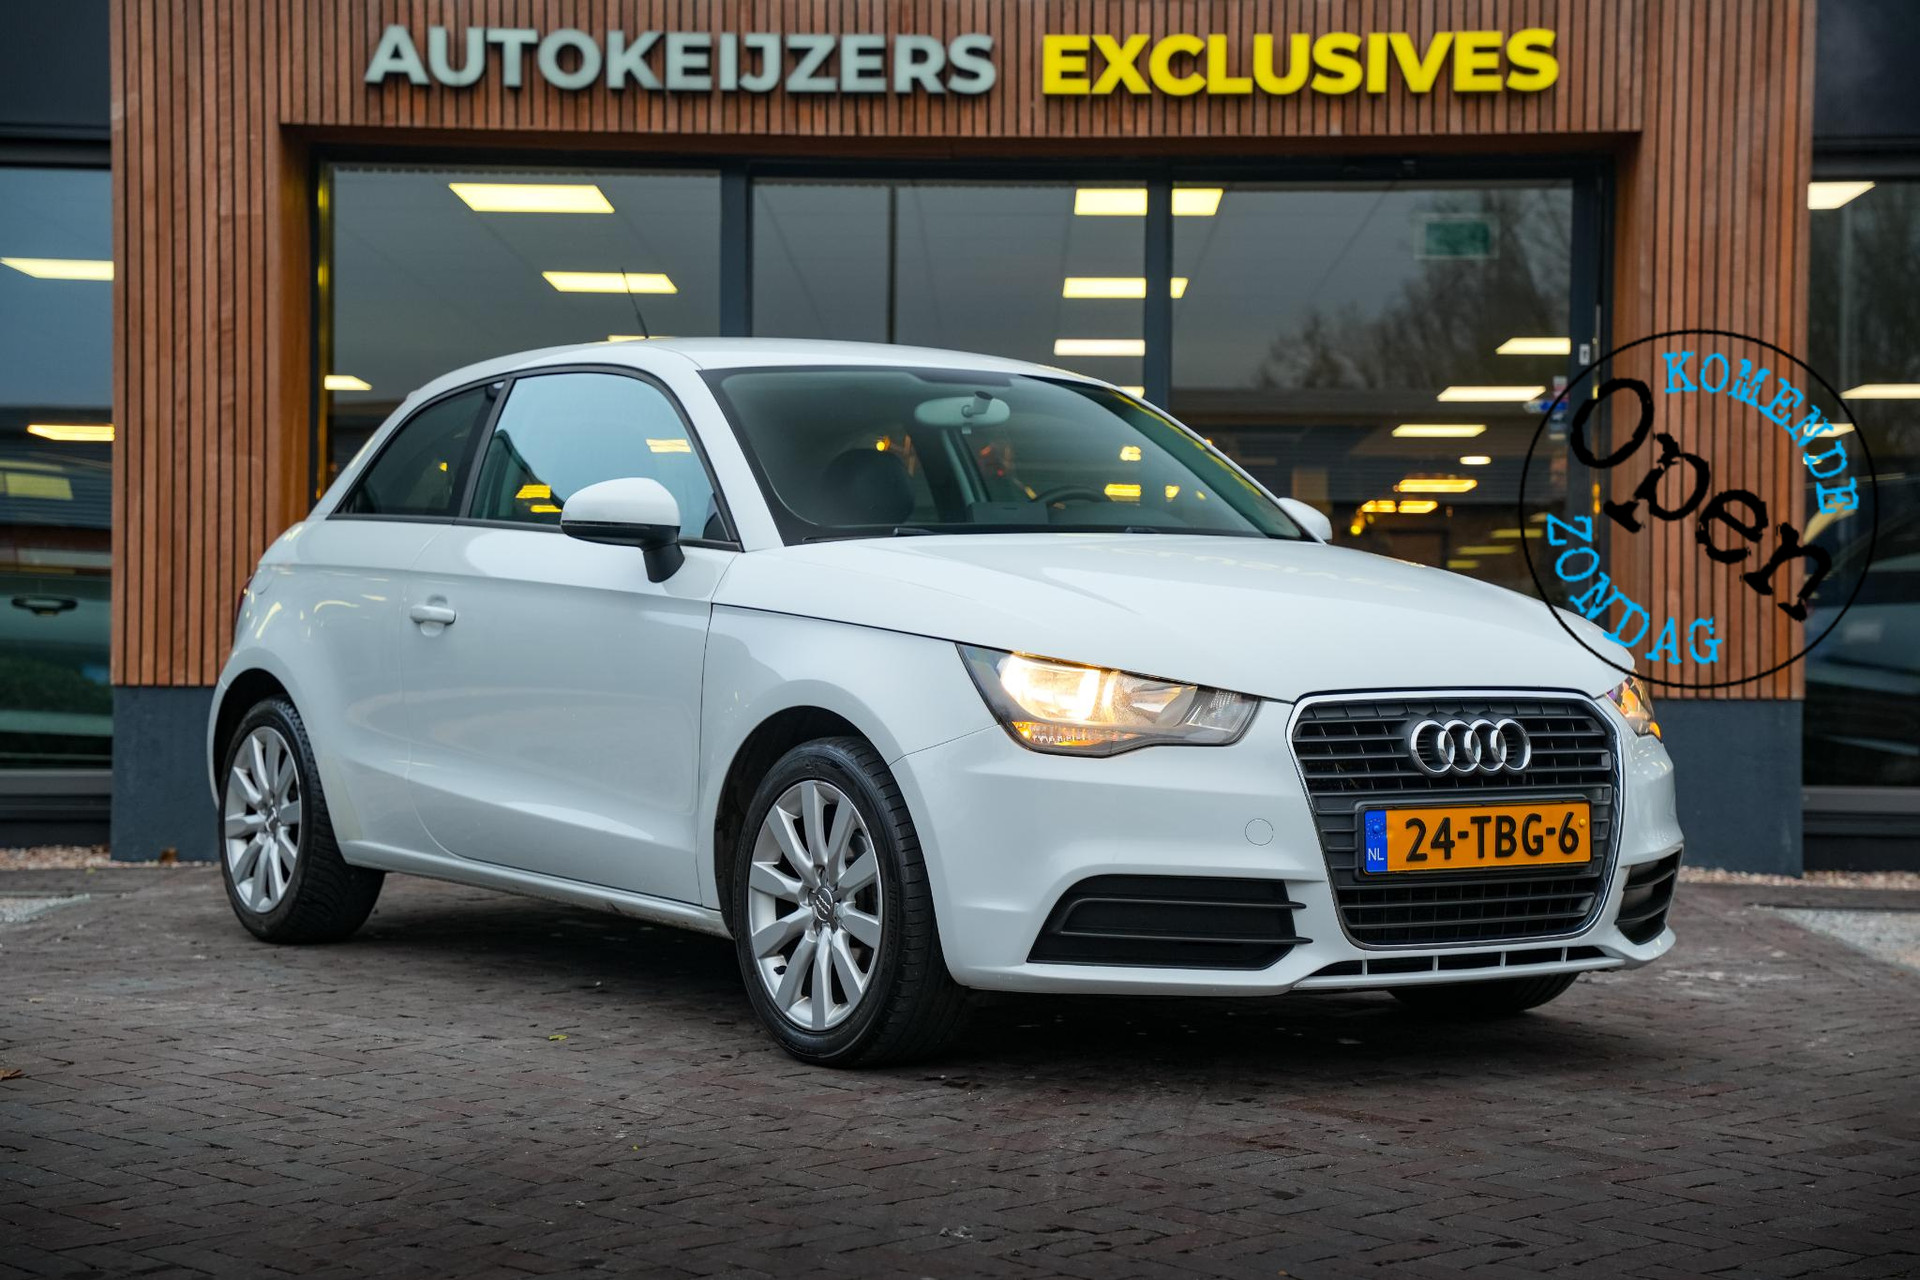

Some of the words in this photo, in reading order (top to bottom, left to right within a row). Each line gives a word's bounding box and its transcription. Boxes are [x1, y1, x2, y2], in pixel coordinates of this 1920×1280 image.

[364, 25, 997, 95] AUTOKEIJZERS
[1042, 28, 1559, 95] EXCLUSIVES
[1368, 848, 1385, 862] NL
[1405, 812, 1579, 862] 24-TBG-6
